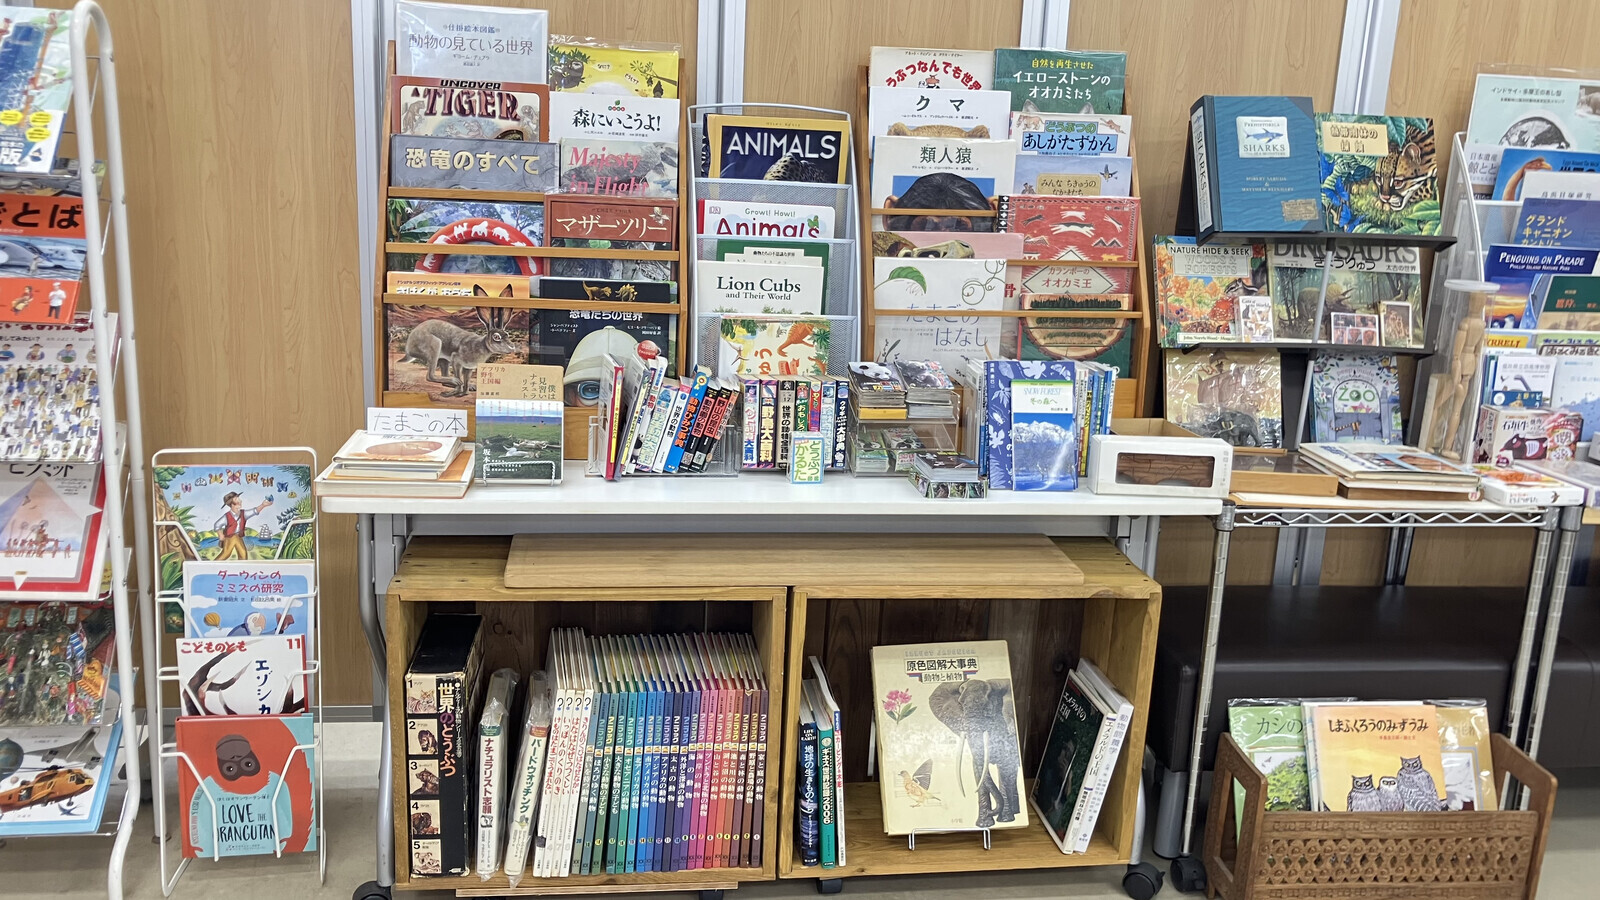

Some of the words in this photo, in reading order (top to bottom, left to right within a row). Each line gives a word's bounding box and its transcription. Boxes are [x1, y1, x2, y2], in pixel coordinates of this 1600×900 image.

[409, 34, 533, 56] 動物の見ている世界
[1031, 58, 1094, 70] 自然を再生させた
[440, 79, 501, 90] UNCOVER
[1013, 71, 1111, 86] イエローストーンの
[1029, 86, 1092, 100] オオカミたち
[423, 88, 521, 122] TIGER
[571, 108, 661, 132] 森にいこうよ!
[1045, 122, 1097, 134] どうぶつの
[726, 132, 836, 159] ANIMALS
[1023, 133, 1115, 151] あしがたずかん
[1243, 144, 1285, 152] SHARKS
[406, 148, 540, 175] 恐竜のすべて
[568, 147, 643, 173] Majesty
[920, 146, 972, 164] 類人猿
[1196, 131, 1207, 190] SHARKS
[570, 175, 588, 194] in
[745, 208, 771, 217] Growl!
[774, 209, 796, 218] Howl!
[1526, 214, 1567, 226] グランド
[556, 215, 667, 238] マザーツリー
[716, 218, 820, 239] Animals
[1522, 228, 1573, 239] キャニオン
[1170, 247, 1200, 255] NATURE
[1202, 247, 1221, 255] HIDE
[1231, 248, 1250, 256] SEEK
[1499, 252, 1539, 264] PENGUINS
[1541, 256, 1551, 264] ON
[1553, 254, 1586, 266] PARADE
[1047, 267, 1090, 276] カランポーの
[716, 276, 755, 291] Lion
[759, 278, 801, 293] Cubs
[1042, 278, 1092, 289] オオカミ王
[743, 292, 764, 300] Their
[767, 292, 791, 301] World
[935, 327, 988, 347] はなし
[530, 374, 538, 400] ナチュラ
[539, 377, 547, 400] 見習い
[548, 384, 556, 400] 僕は
[374, 411, 466, 434] たまごの本
[794, 444, 809, 481] かるた
[807, 440, 821, 475] どうぶつ
[217, 570, 282, 580] ダーウィンの
[215, 583, 284, 593] ミミズの研究
[181, 640, 247, 654] こどものとも
[286, 638, 301, 650] 11
[906, 658, 977, 672] 原色図解大事典
[255, 660, 273, 714] エゾシカ
[408, 680, 413, 688] 1
[409, 721, 416, 729] 2
[438, 682, 457, 777] 世界のどうぶつ
[1328, 718, 1430, 734] しまふくろうのみずうみ
[410, 761, 417, 770] 3
[482, 738, 494, 814] ナチュラリスト志願
[519, 738, 542, 814] バードウォッチング
[222, 803, 254, 824] LOVE
[257, 813, 267, 821] THE
[412, 802, 419, 810] 4
[413, 841, 420, 849] 5
